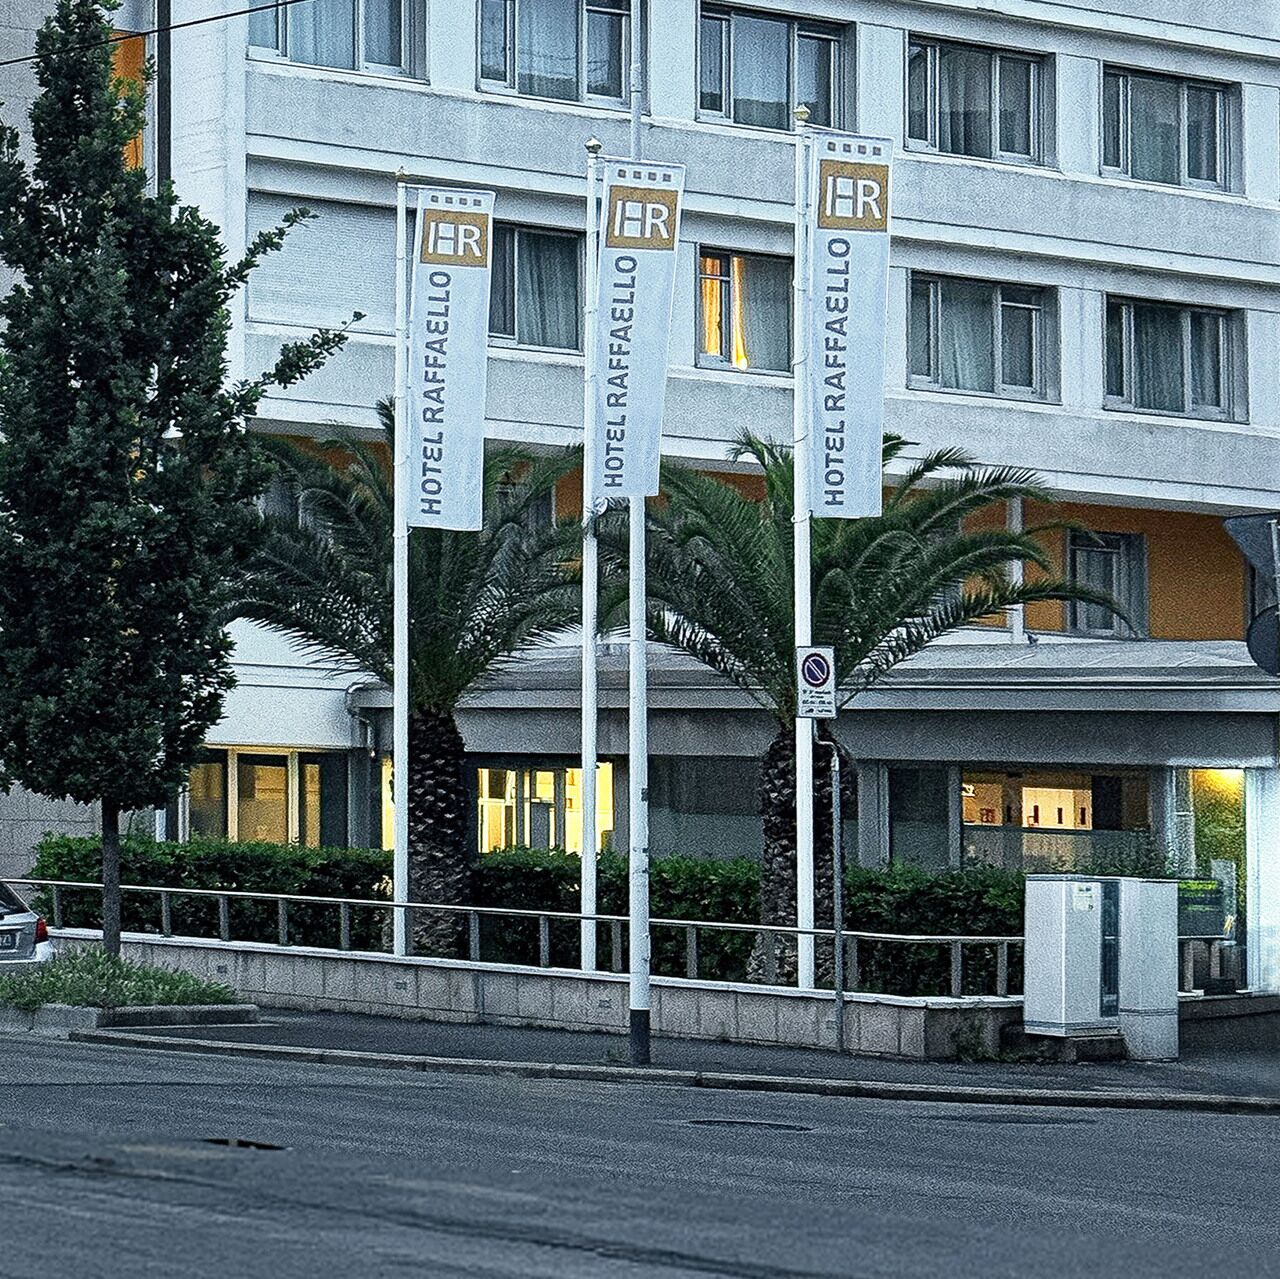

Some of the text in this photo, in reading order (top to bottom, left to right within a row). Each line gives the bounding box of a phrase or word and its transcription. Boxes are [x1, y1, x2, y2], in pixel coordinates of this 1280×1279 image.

[428, 221, 482, 257] HR
[613, 200, 670, 239] HR
[825, 175, 882, 219] HR
[420, 270, 452, 516] HOTEL RAFFAELLO
[604, 255, 638, 488] HOTEL RAFFAELLO
[824, 237, 852, 507] HOTEL RAFFAELLO
